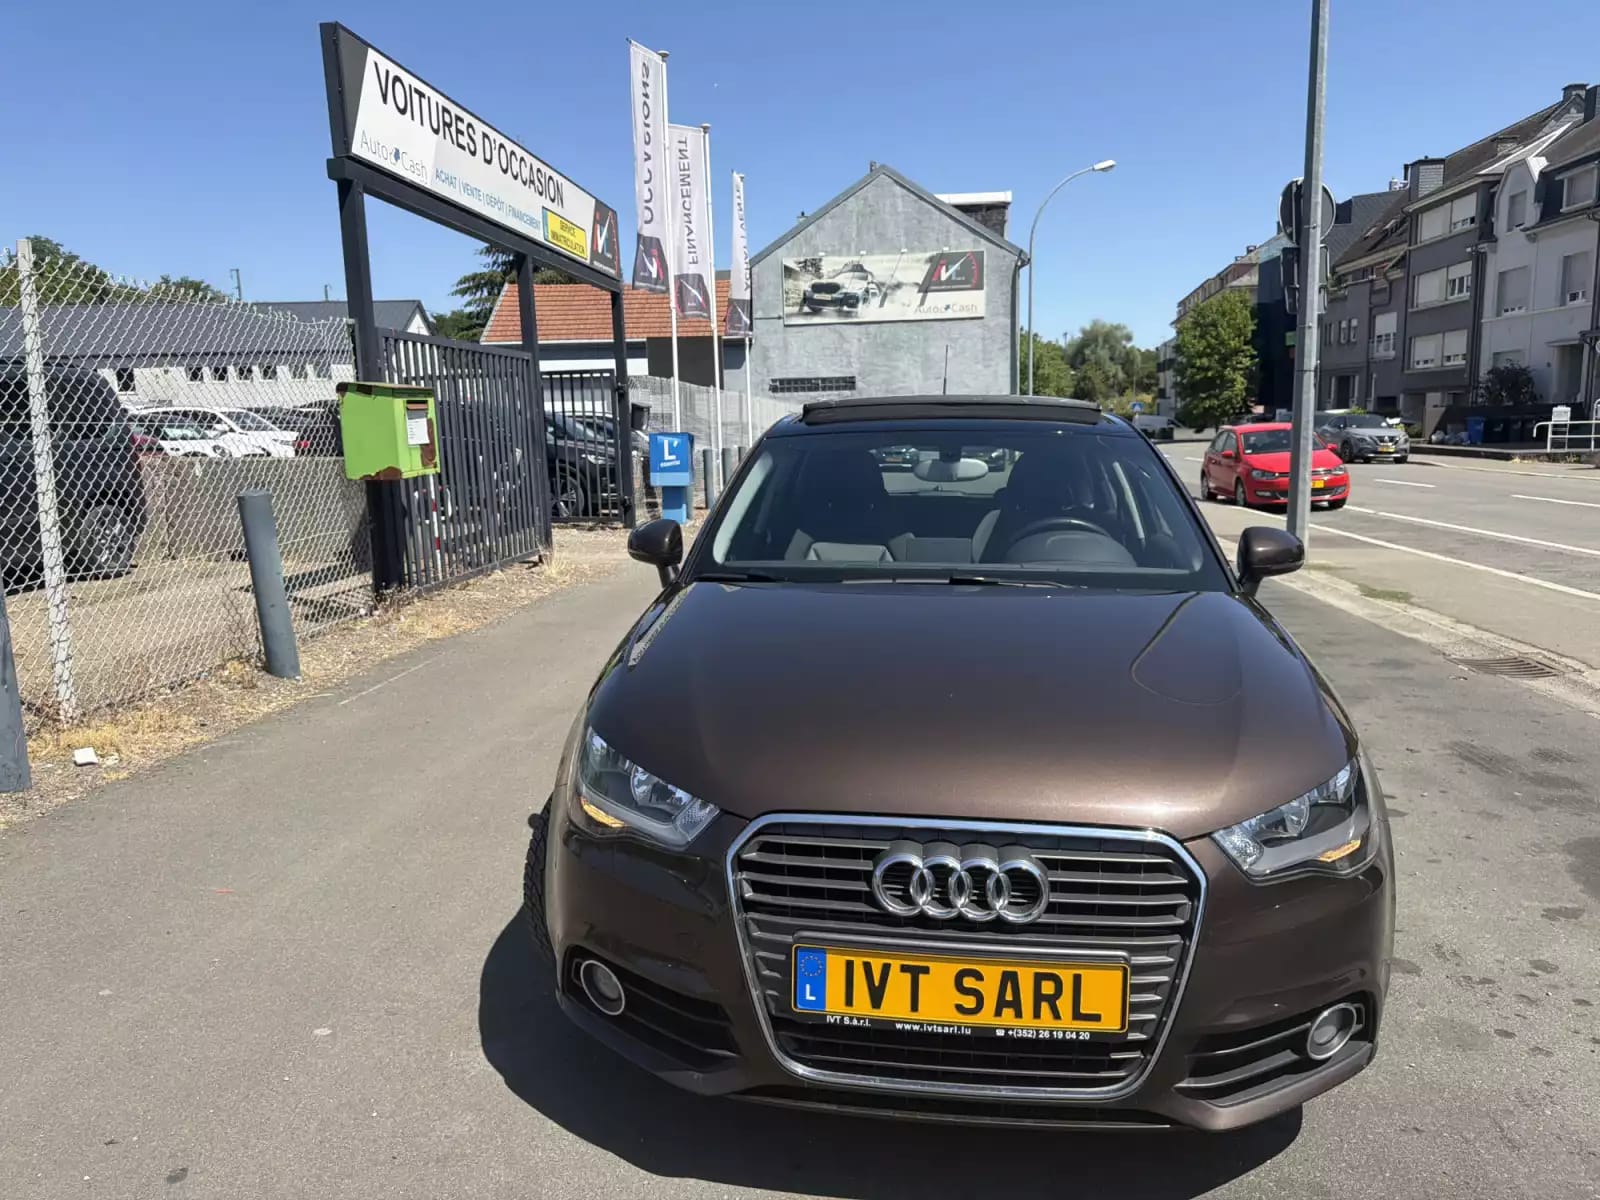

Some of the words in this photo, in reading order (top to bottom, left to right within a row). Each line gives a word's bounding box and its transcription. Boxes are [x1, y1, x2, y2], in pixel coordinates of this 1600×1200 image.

[374, 61, 477, 157] VOITURES
[482, 131, 564, 209] D'OCCASION
[401, 151, 428, 180] Cash
[435, 167, 457, 189] ACHAT
[461, 180, 482, 202] VENTE
[806, 984, 816, 1001] L
[845, 960, 930, 1013] IVT
[954, 968, 1102, 1023] SARL
[826, 1015, 841, 1025] IVT
[895, 1022, 972, 1035] www.ivtsarl.lu
[1038, 1030, 1050, 1039] 26
[1052, 1030, 1063, 1039] 19
[1065, 1031, 1077, 1040] 04
[1078, 1031, 1090, 1041] 20
